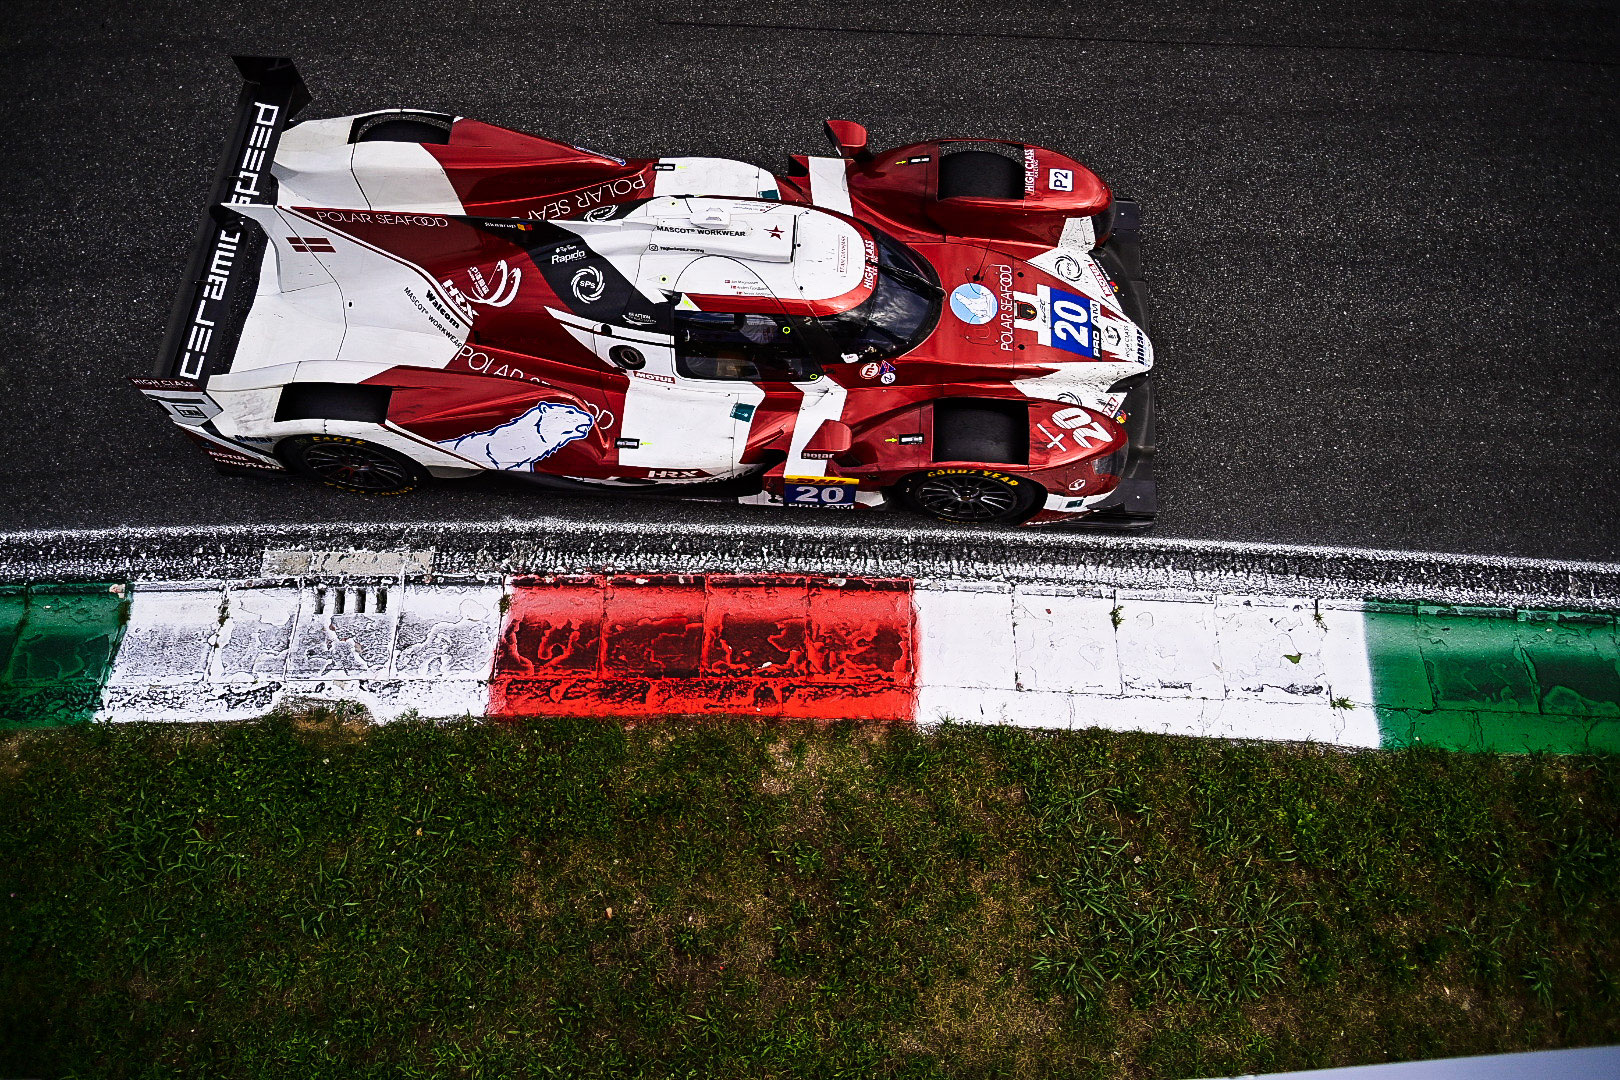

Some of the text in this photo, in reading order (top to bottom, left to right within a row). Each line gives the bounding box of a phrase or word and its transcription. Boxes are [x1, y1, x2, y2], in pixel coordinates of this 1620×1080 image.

[575, 174, 646, 207] POLAR
[1054, 171, 1068, 188] P2
[316, 211, 449, 228] POLAR SEAFOOD
[696, 228, 746, 237] WORKWEAR
[551, 249, 586, 265] Rapido
[863, 265, 874, 291] HIGH
[425, 289, 460, 330] Walcom
[442, 278, 480, 320] HRX
[1000, 263, 1013, 352] POLAR SEAFOOD
[428, 314, 463, 349] WORKWEAR
[1053, 300, 1089, 348] 20
[1090, 303, 1101, 358] PRO AM
[635, 371, 674, 383] MOTUL
[1052, 407, 1114, 449] 20
[647, 470, 699, 478] HRX
[795, 486, 844, 503] 20
